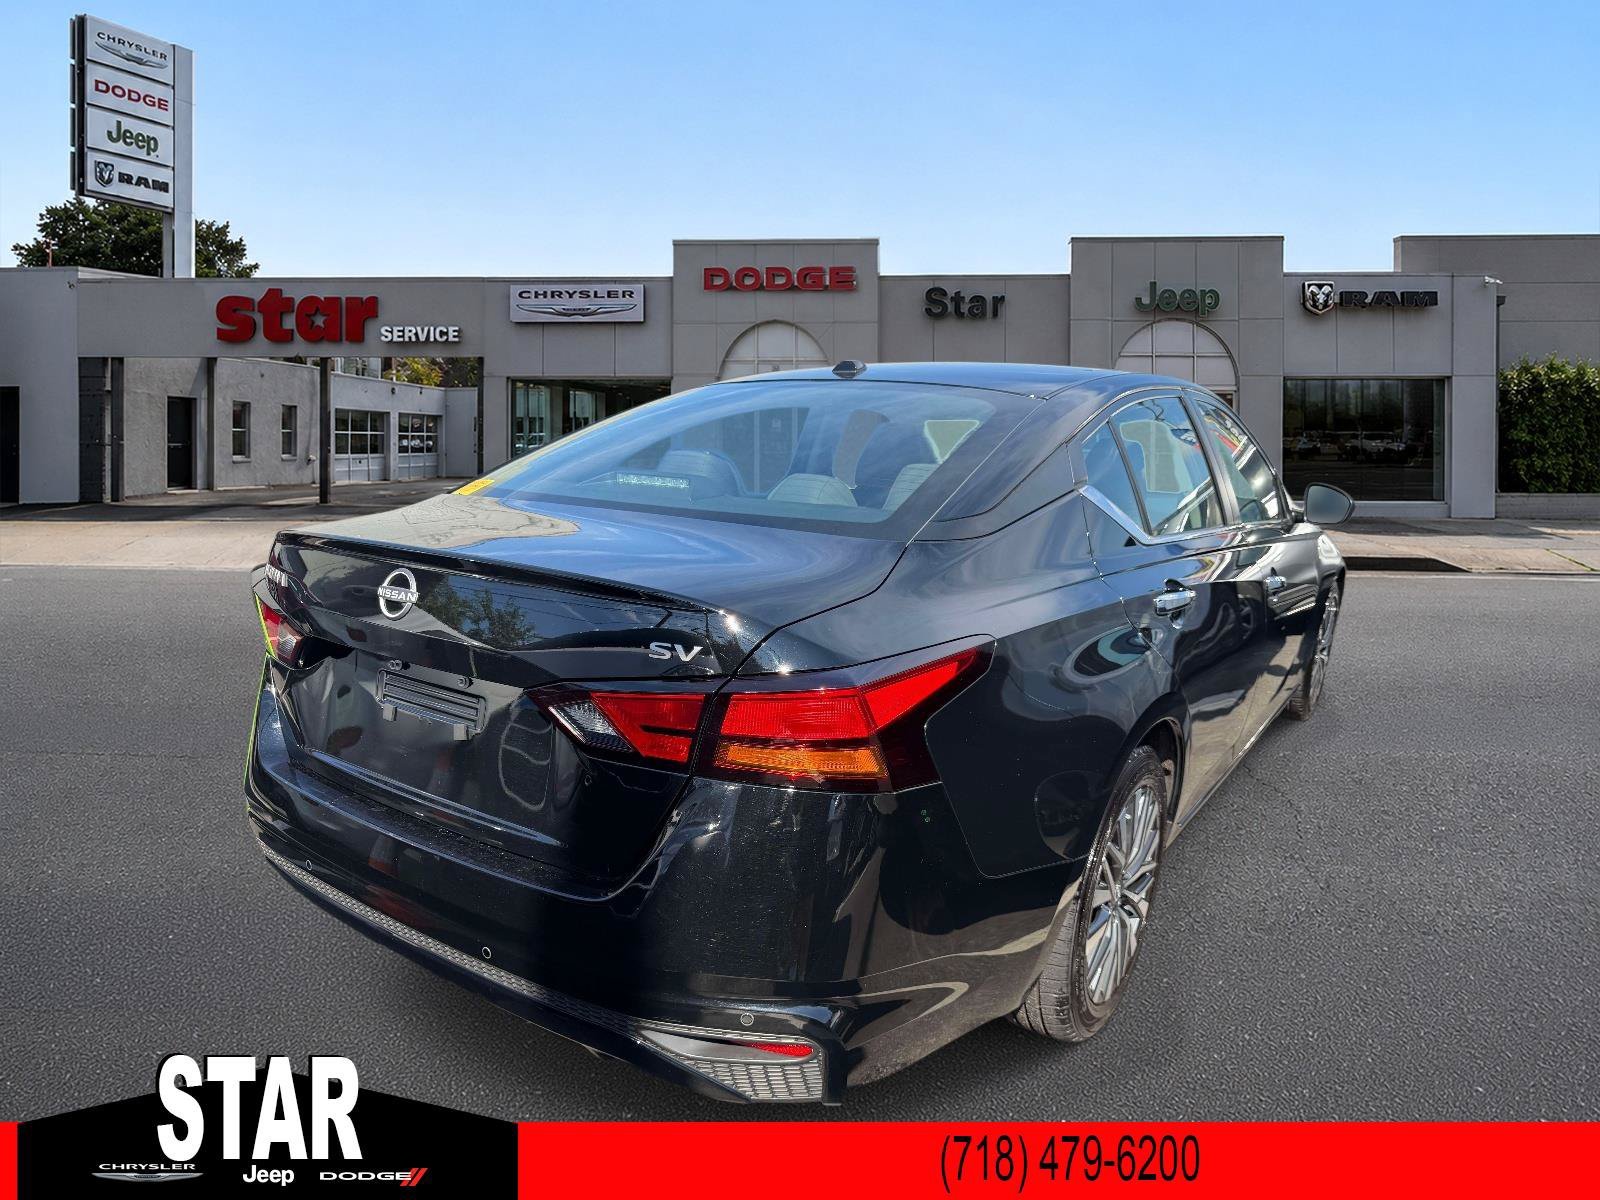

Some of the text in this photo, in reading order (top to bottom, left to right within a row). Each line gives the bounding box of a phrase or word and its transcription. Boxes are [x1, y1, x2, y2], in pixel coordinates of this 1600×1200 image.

[97, 31, 168, 61] CHRYSLER
[94, 79, 169, 112] DODGE
[106, 120, 159, 156] Jeep
[117, 171, 169, 194] RAM
[702, 266, 857, 292] DODGE
[518, 290, 635, 299] CHRYSLER
[924, 286, 1006, 320] Star
[1135, 281, 1221, 316] Jeep
[1338, 290, 1439, 308] RAM
[215, 287, 461, 344] star SERVICE
[377, 587, 417, 602] NISSAN
[648, 642, 704, 662] SV
